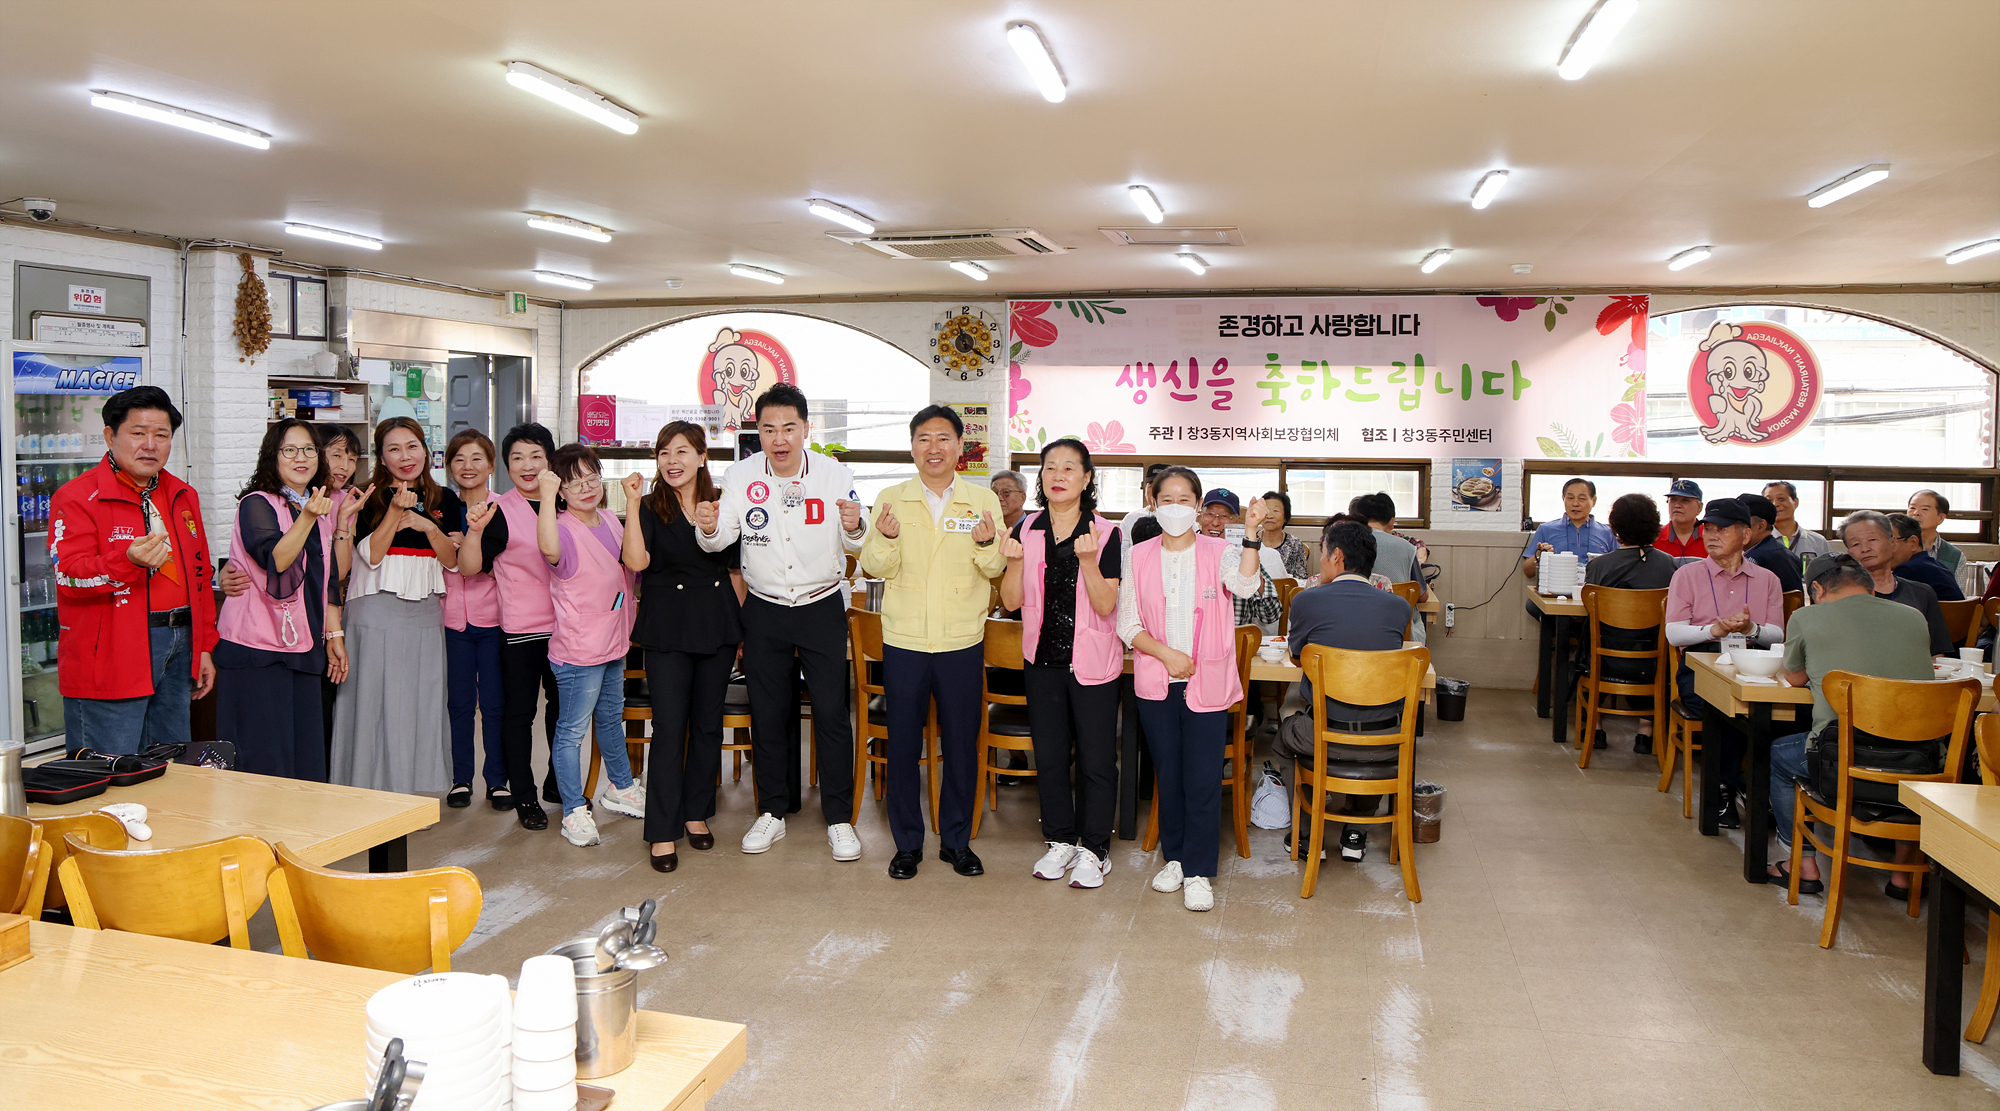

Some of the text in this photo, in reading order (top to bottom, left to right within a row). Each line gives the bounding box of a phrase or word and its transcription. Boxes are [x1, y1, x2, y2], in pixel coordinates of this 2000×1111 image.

[961, 306, 970, 314] 12
[946, 311, 952, 319] 11
[979, 311, 983, 319] 1
[935, 322, 942, 331] 10
[990, 323, 997, 331] 2
[1218, 314, 1304, 338] 존경하고
[1309, 313, 1421, 338] 사랑합니다
[930, 338, 937, 347] 9
[993, 340, 1001, 348] 3
[933, 355, 941, 364] 8
[945, 368, 951, 376] 7
[960, 372, 968, 381] 6
[976, 369, 984, 377] 5
[55, 369, 136, 390] MAGICE
[1115, 353, 1532, 413] 생신을 축하드립니다
[586, 418, 610, 427] 인기맛집
[1149, 426, 1493, 444] 주관 창3동지역사회보장협의체 협조 창3동주민센터
[805, 498, 825, 525] D
